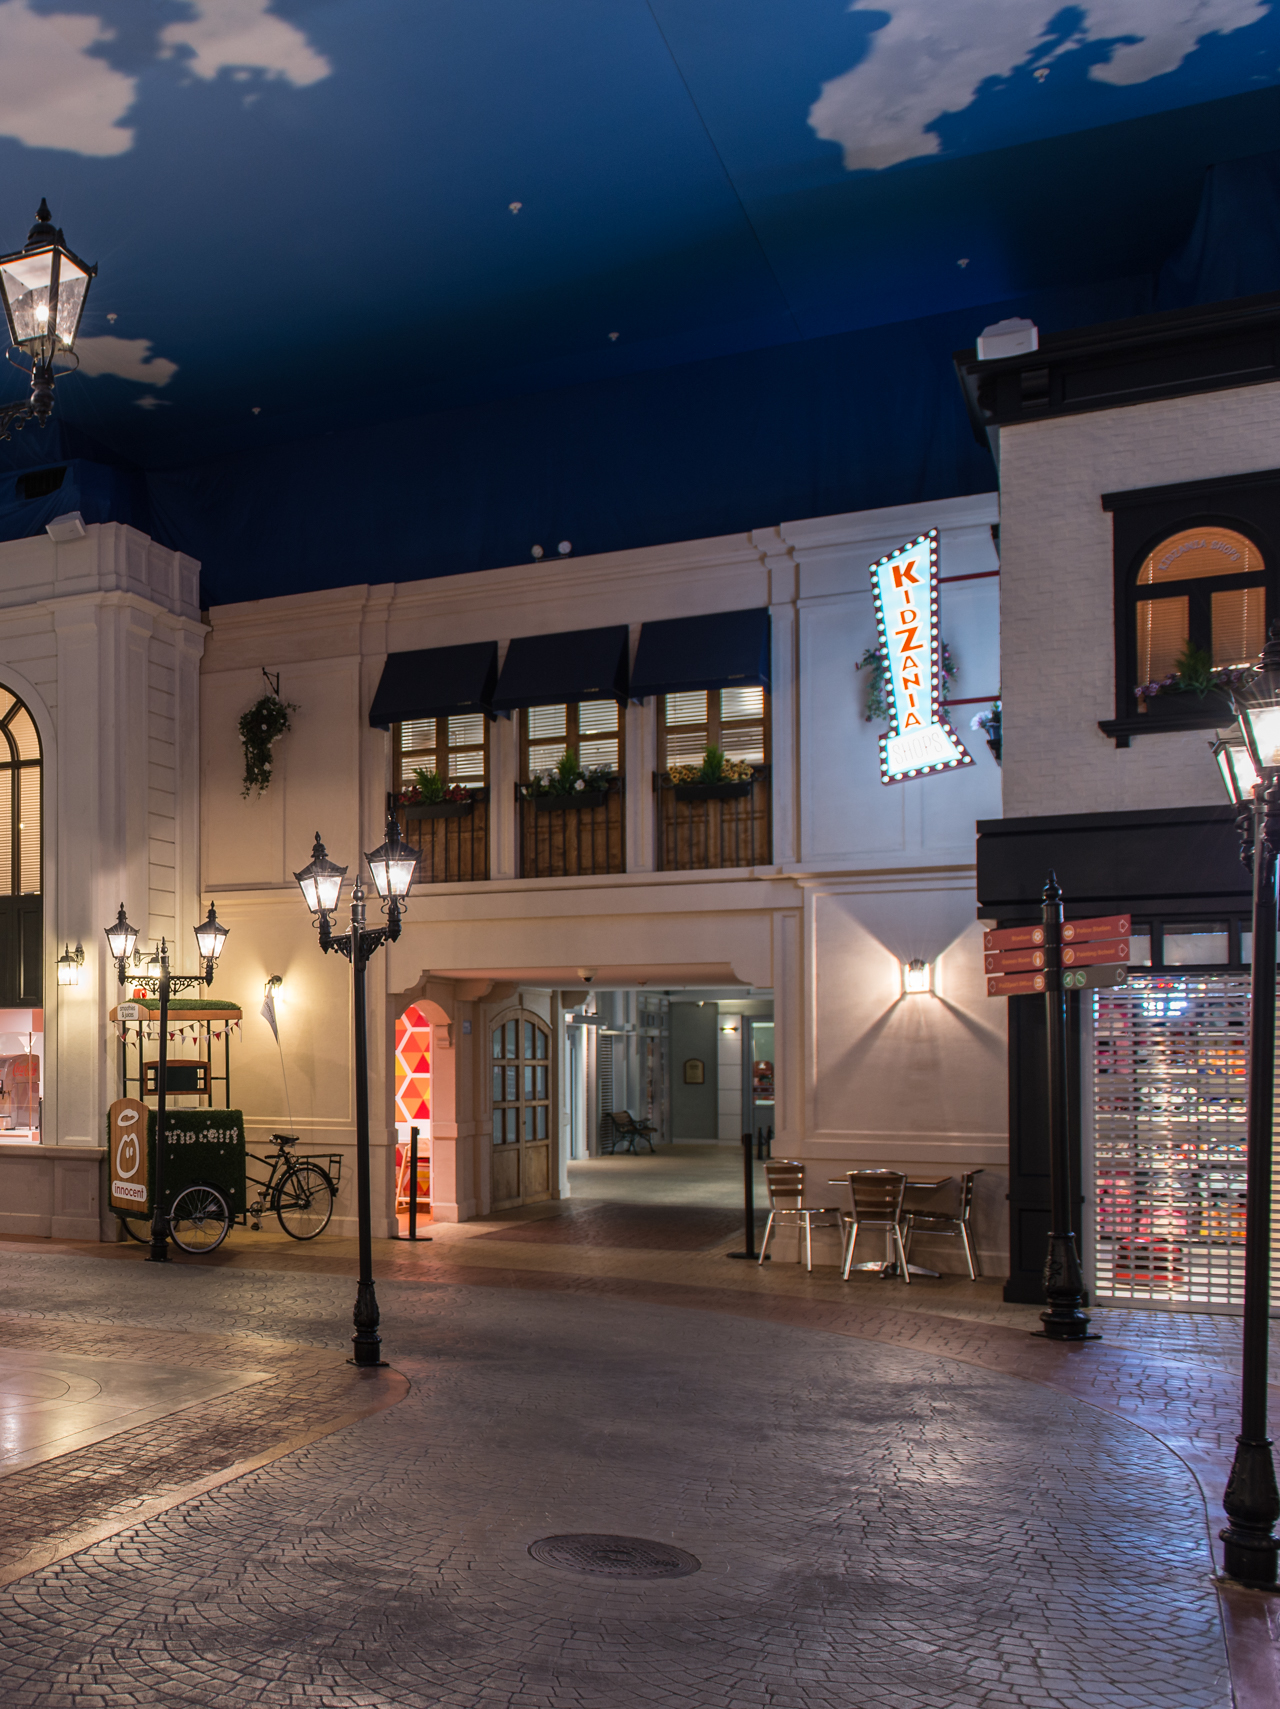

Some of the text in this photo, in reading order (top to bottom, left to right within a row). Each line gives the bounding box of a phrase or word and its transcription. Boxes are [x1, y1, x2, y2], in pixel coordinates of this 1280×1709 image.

[1157, 538, 1241, 571] KIDZANIA SHOPS
[891, 559, 924, 730] KIDZANIA
[891, 731, 943, 766] SHOPS
[114, 1182, 144, 1200] innocent
